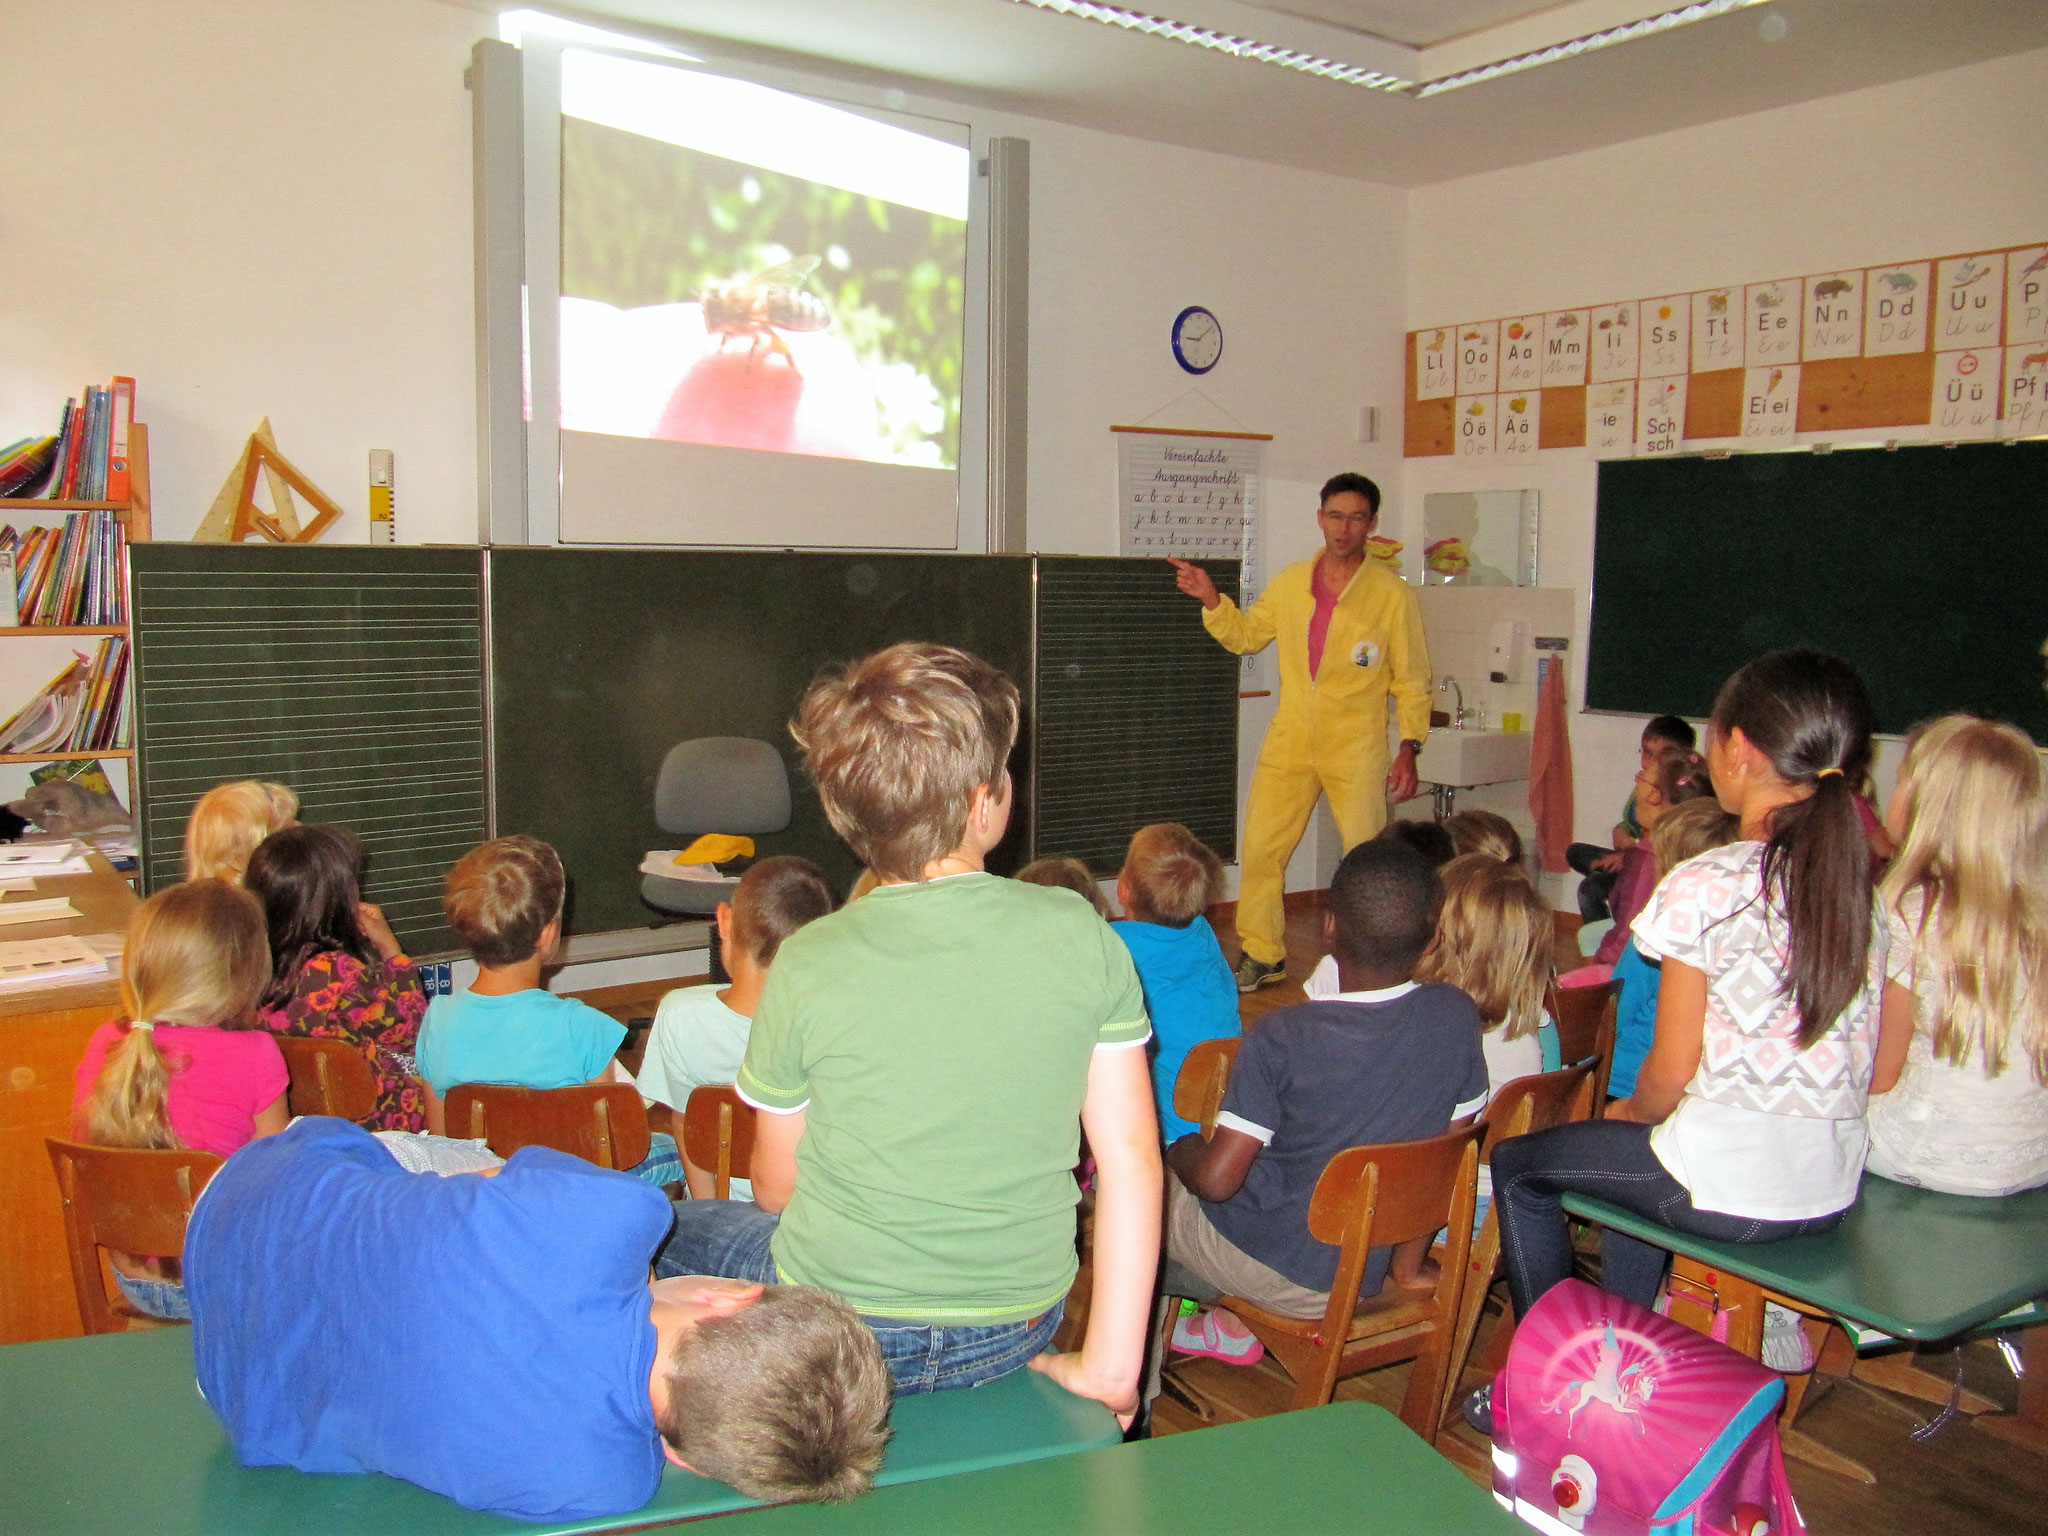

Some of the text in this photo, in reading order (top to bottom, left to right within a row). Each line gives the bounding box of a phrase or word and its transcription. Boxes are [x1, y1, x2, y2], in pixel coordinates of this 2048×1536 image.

[1647, 417, 1676, 434] Sch
[1647, 434, 1674, 452] sch
[1163, 447, 1229, 467] Vereinfachte
[1153, 468, 1239, 489] Ausgangsschrift
